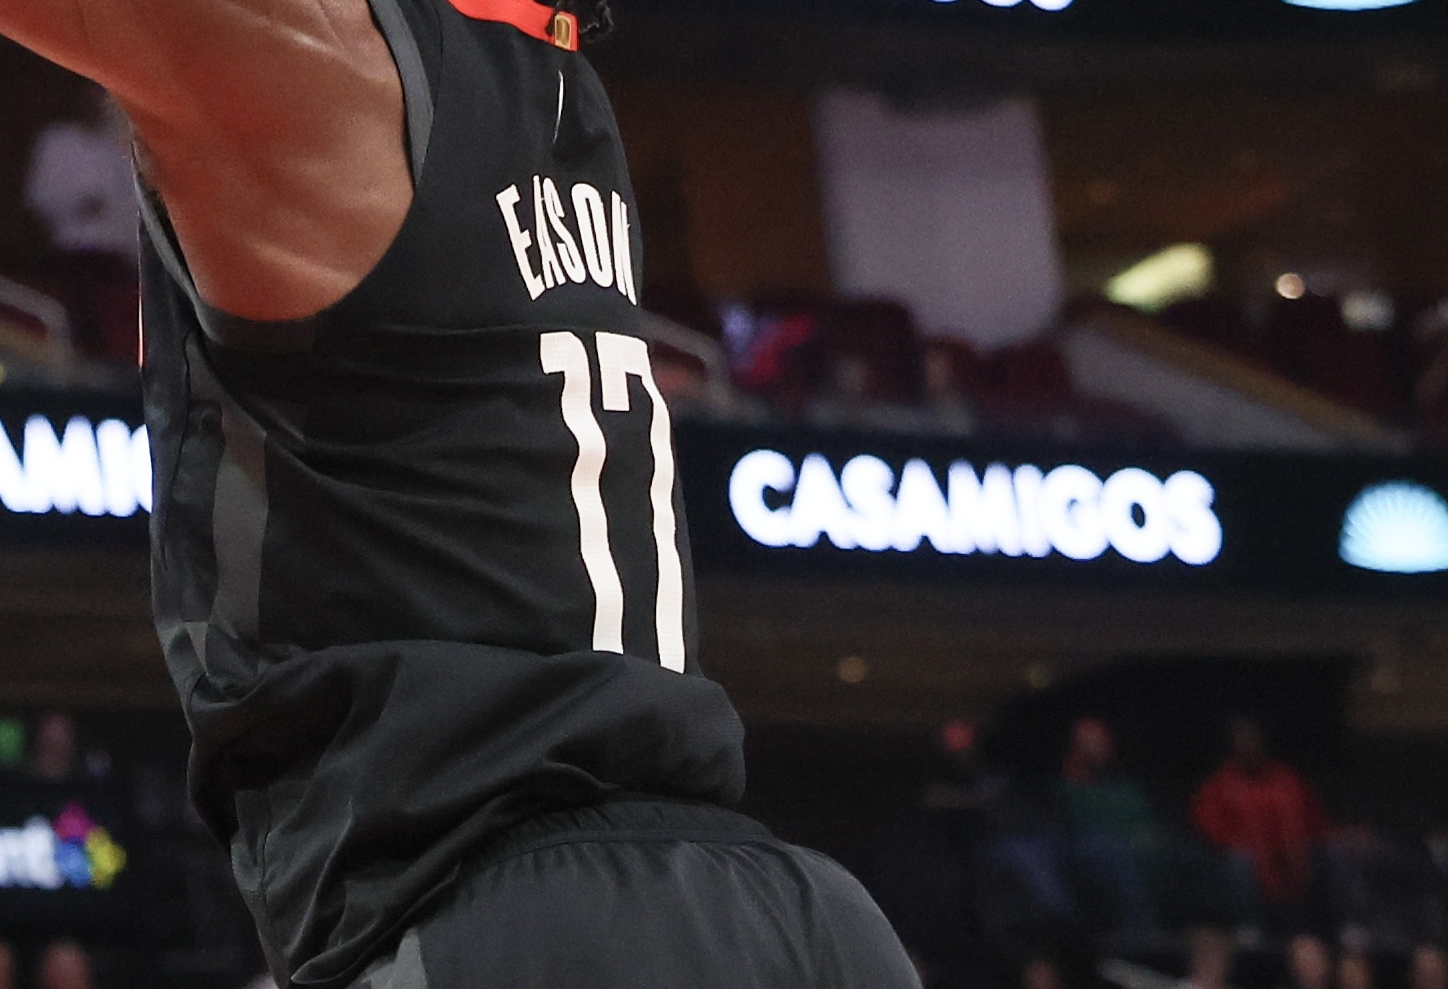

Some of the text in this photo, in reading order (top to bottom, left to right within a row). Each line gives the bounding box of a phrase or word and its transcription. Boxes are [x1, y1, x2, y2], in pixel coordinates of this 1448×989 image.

[496, 174, 637, 307] EASON
[539, 331, 686, 675] 17
[729, 448, 1223, 566] CASAMIGOS
